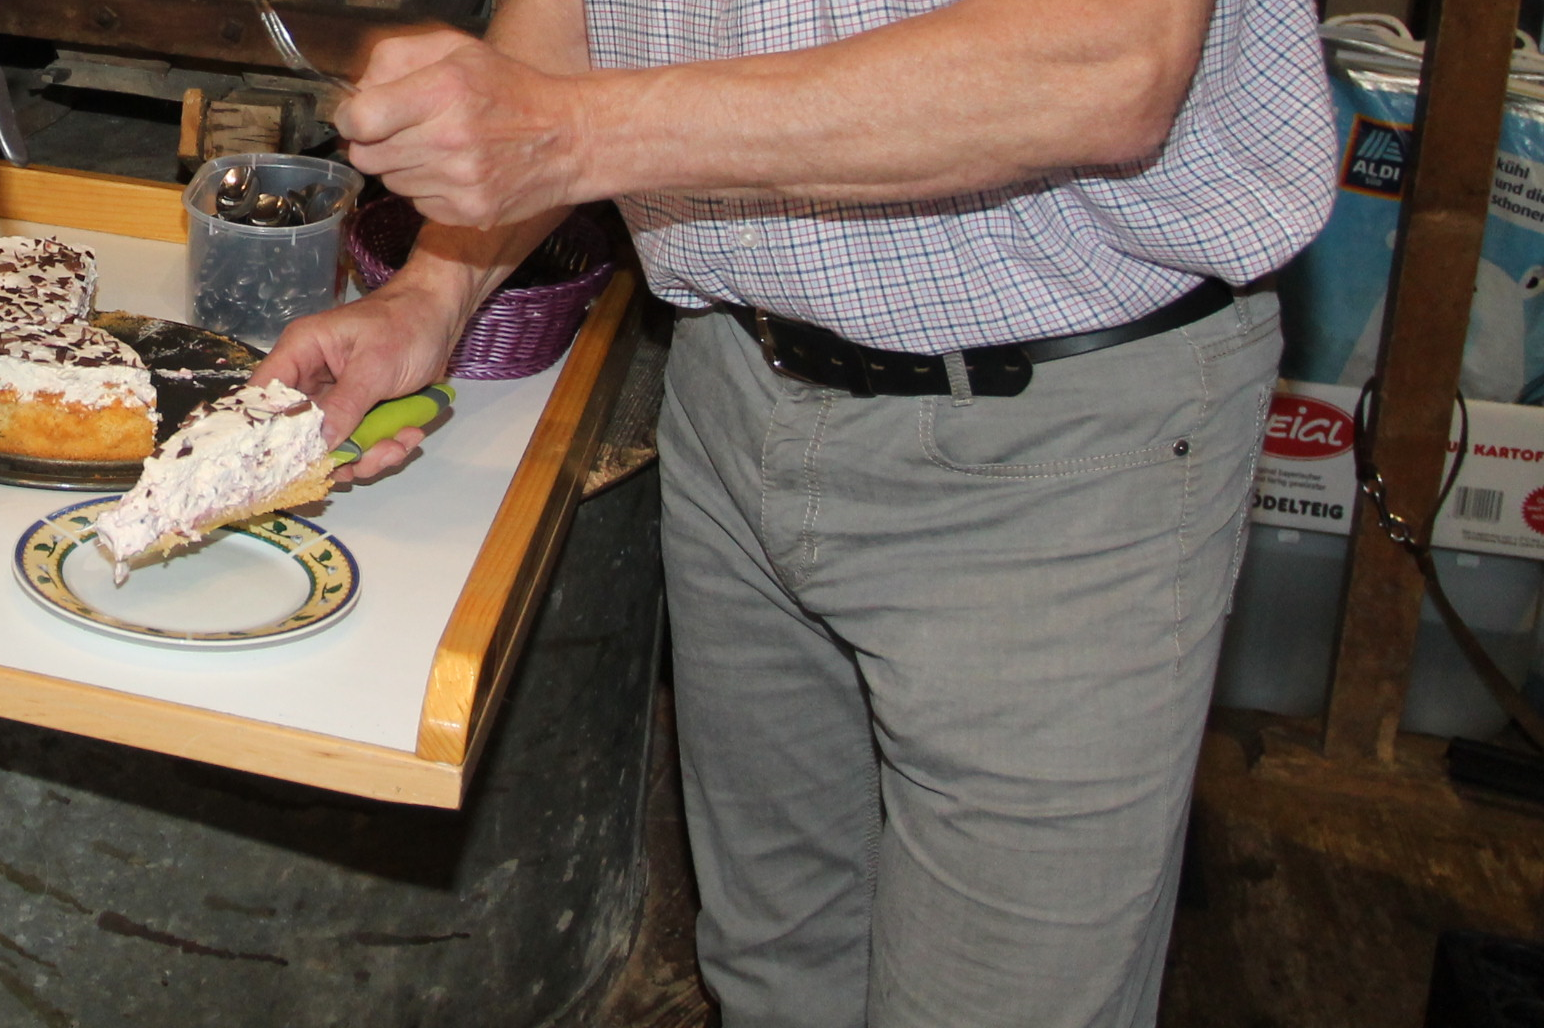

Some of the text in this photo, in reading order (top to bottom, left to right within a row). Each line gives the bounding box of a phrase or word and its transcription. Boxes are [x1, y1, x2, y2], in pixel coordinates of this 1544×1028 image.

[1353, 159, 1400, 181] ALDI
[1497, 157, 1530, 179] kühl
[1495, 178, 1523, 195] und
[1474, 444, 1544, 462] KARTOF
[1252, 488, 1344, 520] ÖDELTEIG
